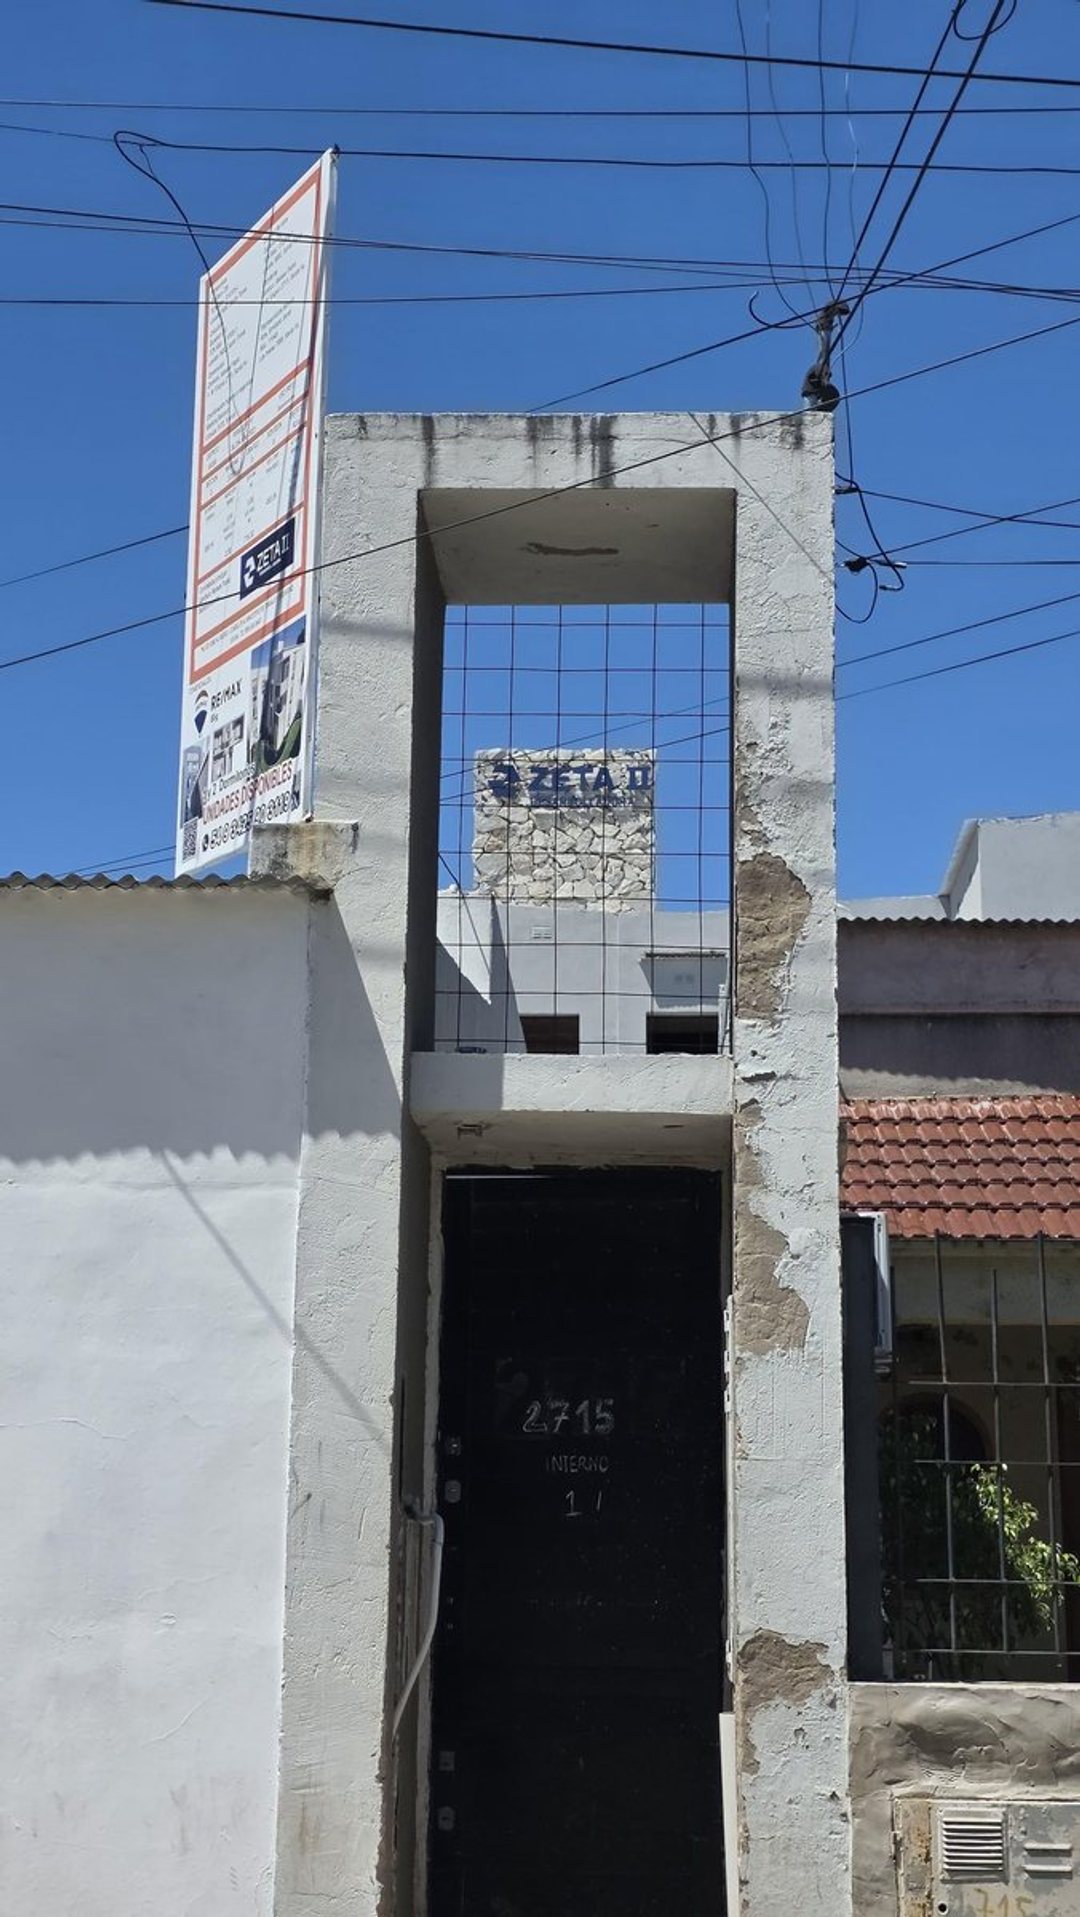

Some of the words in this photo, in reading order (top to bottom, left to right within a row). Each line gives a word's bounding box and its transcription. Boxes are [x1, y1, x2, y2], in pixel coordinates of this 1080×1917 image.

[257, 540, 281, 572] ZETA
[282, 534, 290, 555] II
[210, 681, 242, 711] RE/MAX
[203, 790, 240, 825] UNIDADES
[241, 759, 293, 805] DISPONIBLES
[219, 762, 257, 792] Dormitorios
[528, 763, 615, 792] ZETA
[627, 765, 652, 791] II
[522, 1398, 615, 1435] 2715
[545, 1454, 609, 1473] INTERNO
[565, 1489, 583, 1517] 1
